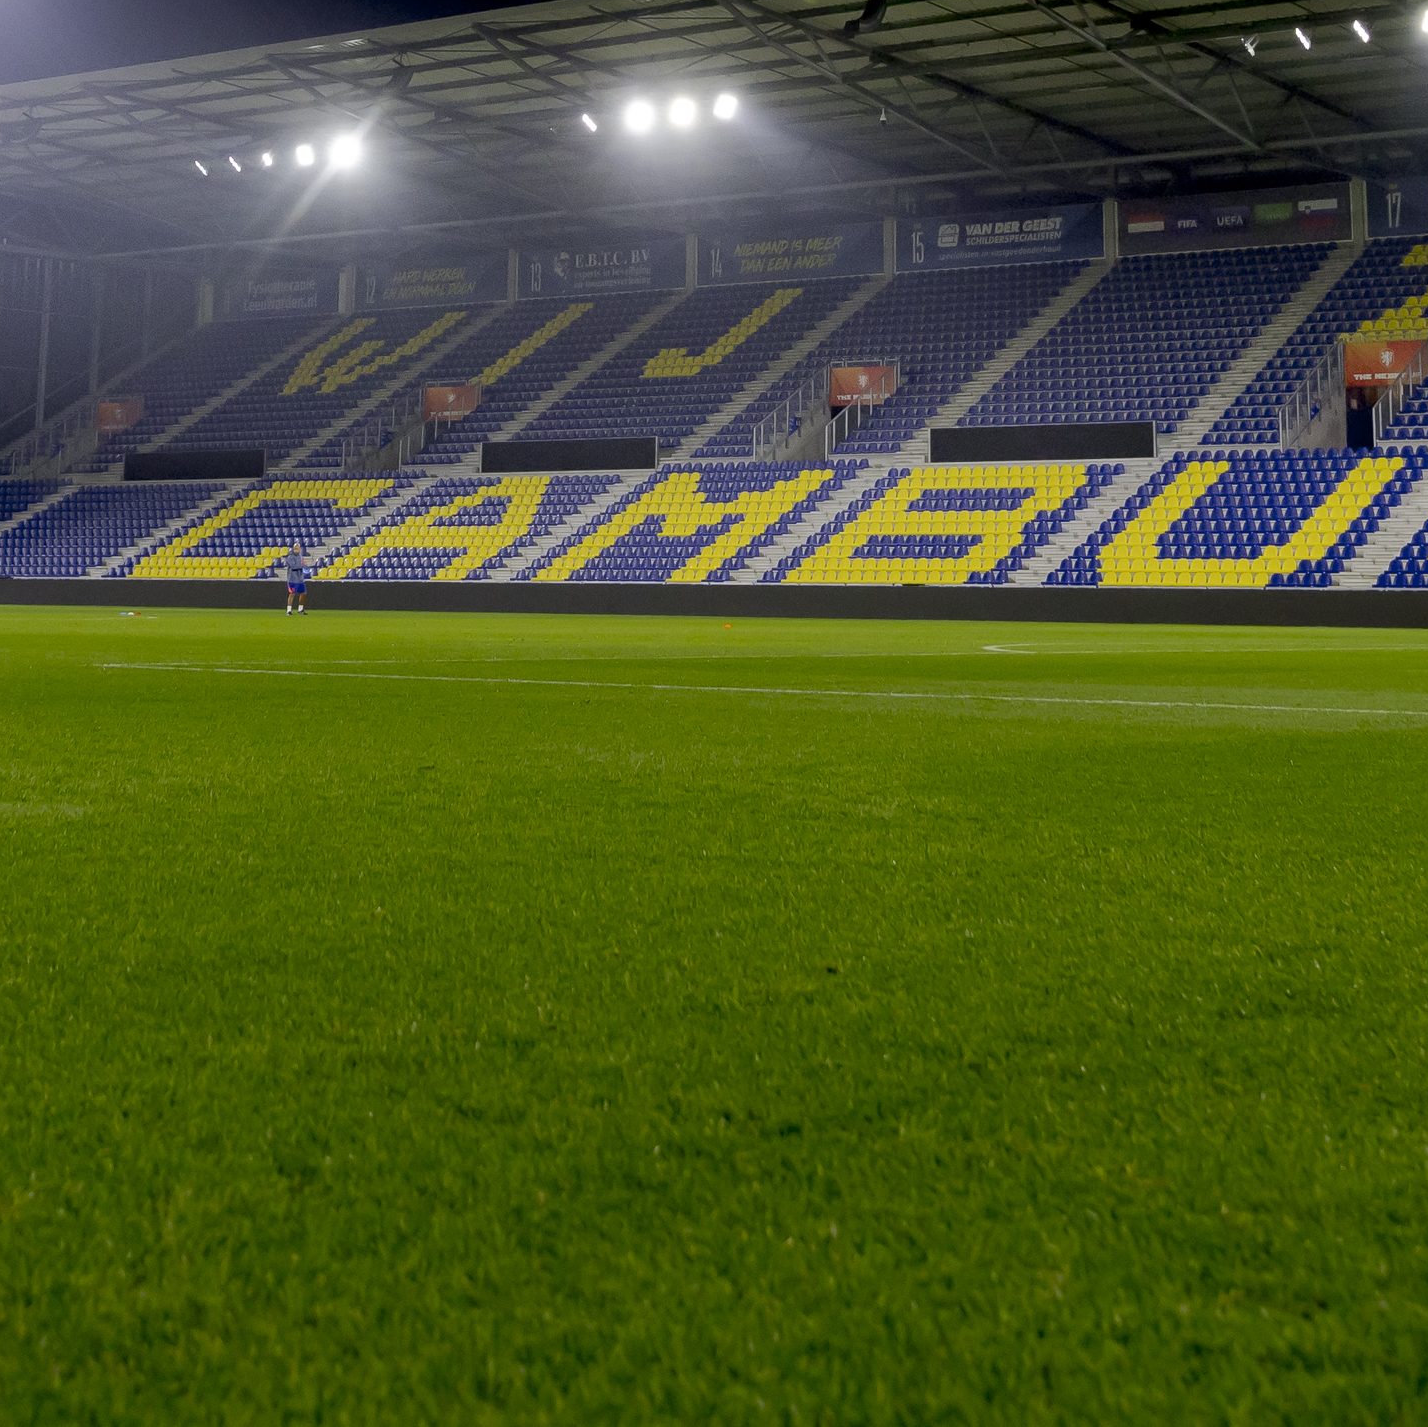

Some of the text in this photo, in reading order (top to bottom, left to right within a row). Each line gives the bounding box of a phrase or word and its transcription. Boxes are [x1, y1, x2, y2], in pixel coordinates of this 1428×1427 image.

[1385, 192, 1402, 228] 17
[965, 217, 1063, 236] VAN DER GEEST
[1177, 219, 1198, 229] FIFA
[1216, 215, 1244, 227] UEFA
[733, 235, 844, 257] NIEMAND IS MEER
[911, 231, 925, 264] 15
[965, 231, 1063, 246] SCHILDERSPECIALISTEN
[630, 248, 651, 264] BV
[710, 248, 723, 278] 14
[739, 253, 838, 274] DAN EEN ANDER
[530, 262, 542, 292] 13
